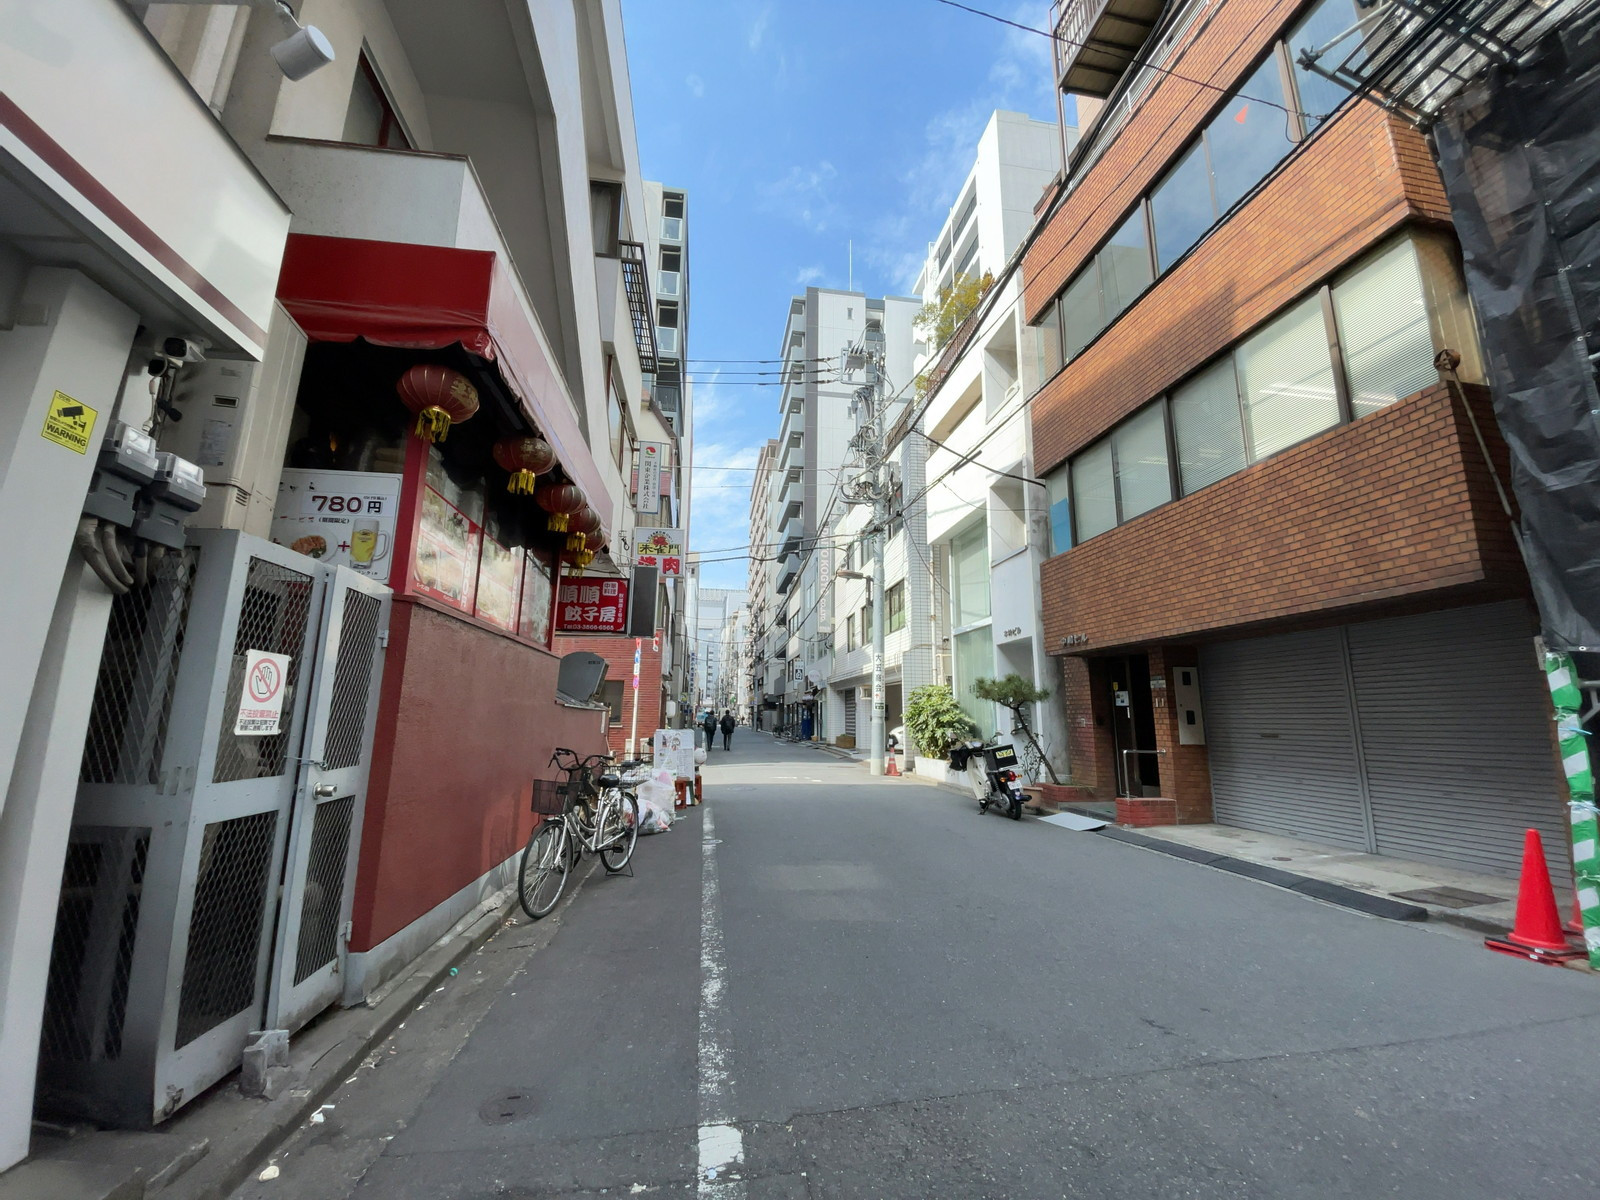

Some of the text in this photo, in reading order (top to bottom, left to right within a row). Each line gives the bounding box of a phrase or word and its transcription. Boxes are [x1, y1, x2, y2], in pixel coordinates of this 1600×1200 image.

[46, 423, 87, 447] WARNING
[312, 495, 382, 514] 780円
[558, 585, 600, 604] 順順
[565, 606, 617, 623] 餃子房
